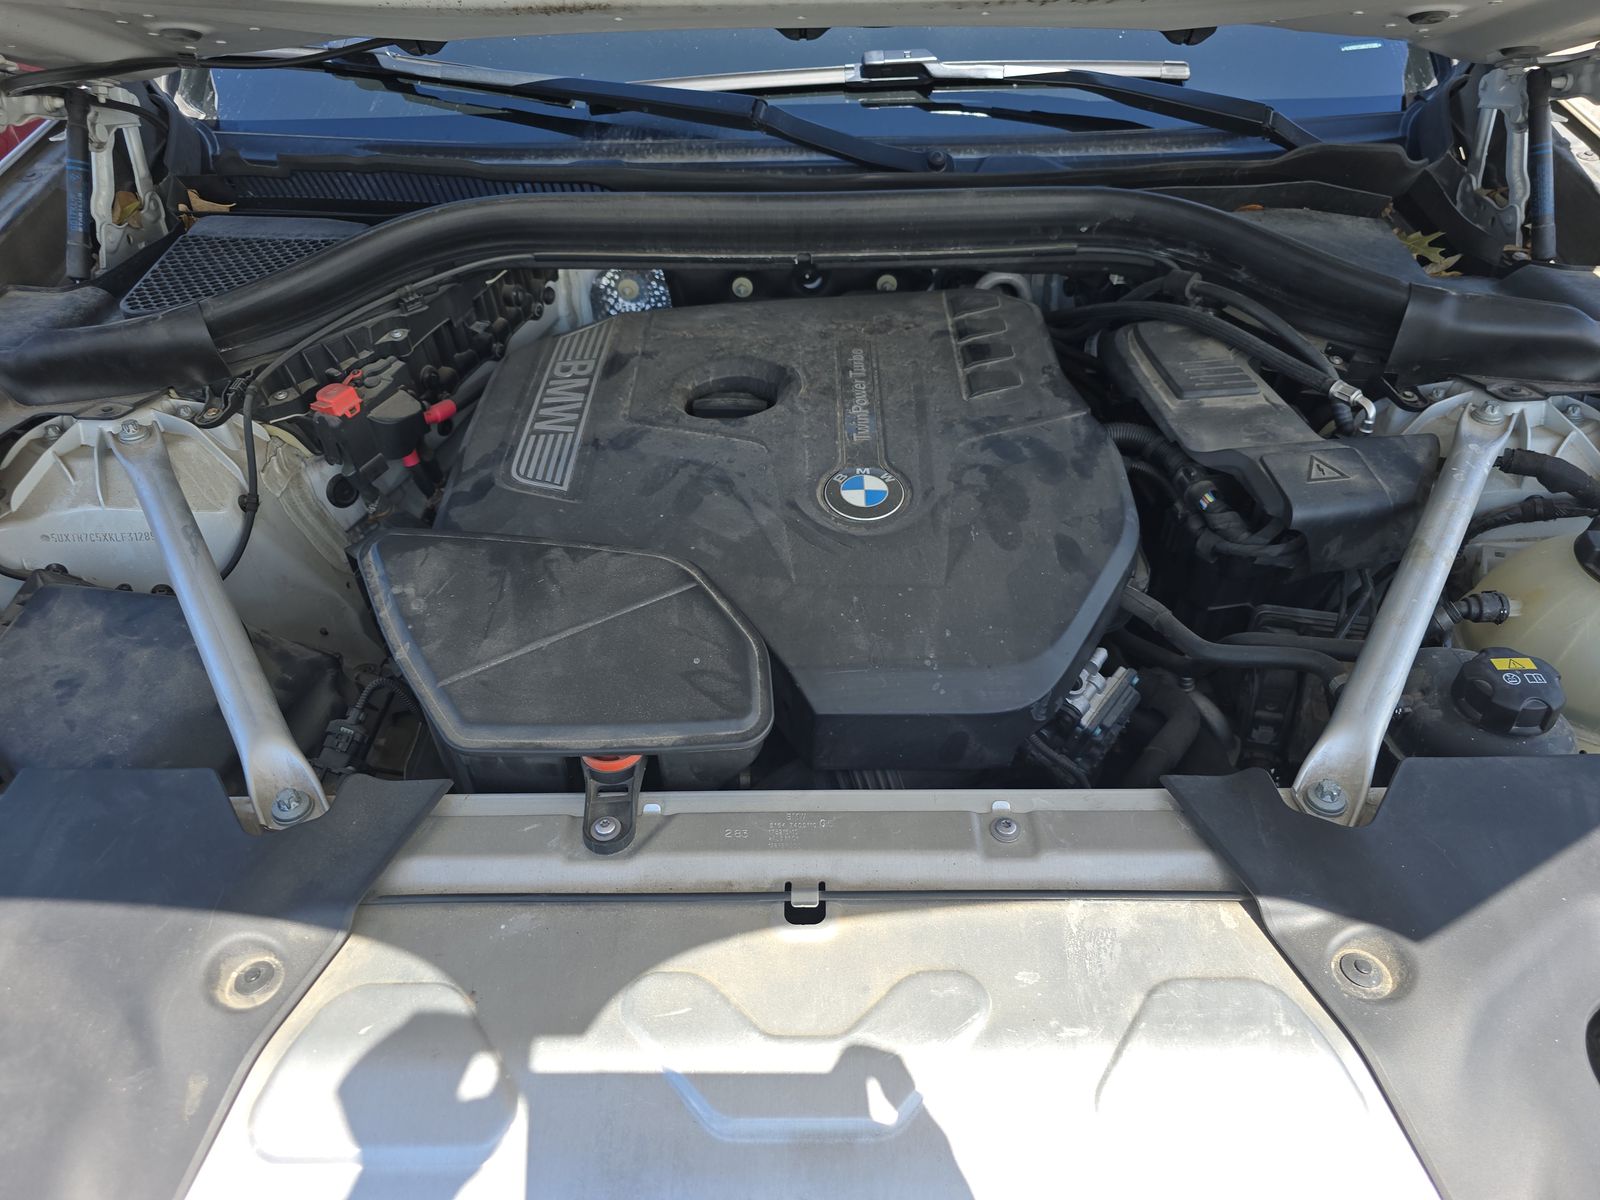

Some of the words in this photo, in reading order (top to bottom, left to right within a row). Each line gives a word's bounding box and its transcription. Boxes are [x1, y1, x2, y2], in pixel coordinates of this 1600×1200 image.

[849, 348, 865, 379] Turbo
[534, 360, 595, 432] BMW
[851, 379, 871, 441] TwinPower
